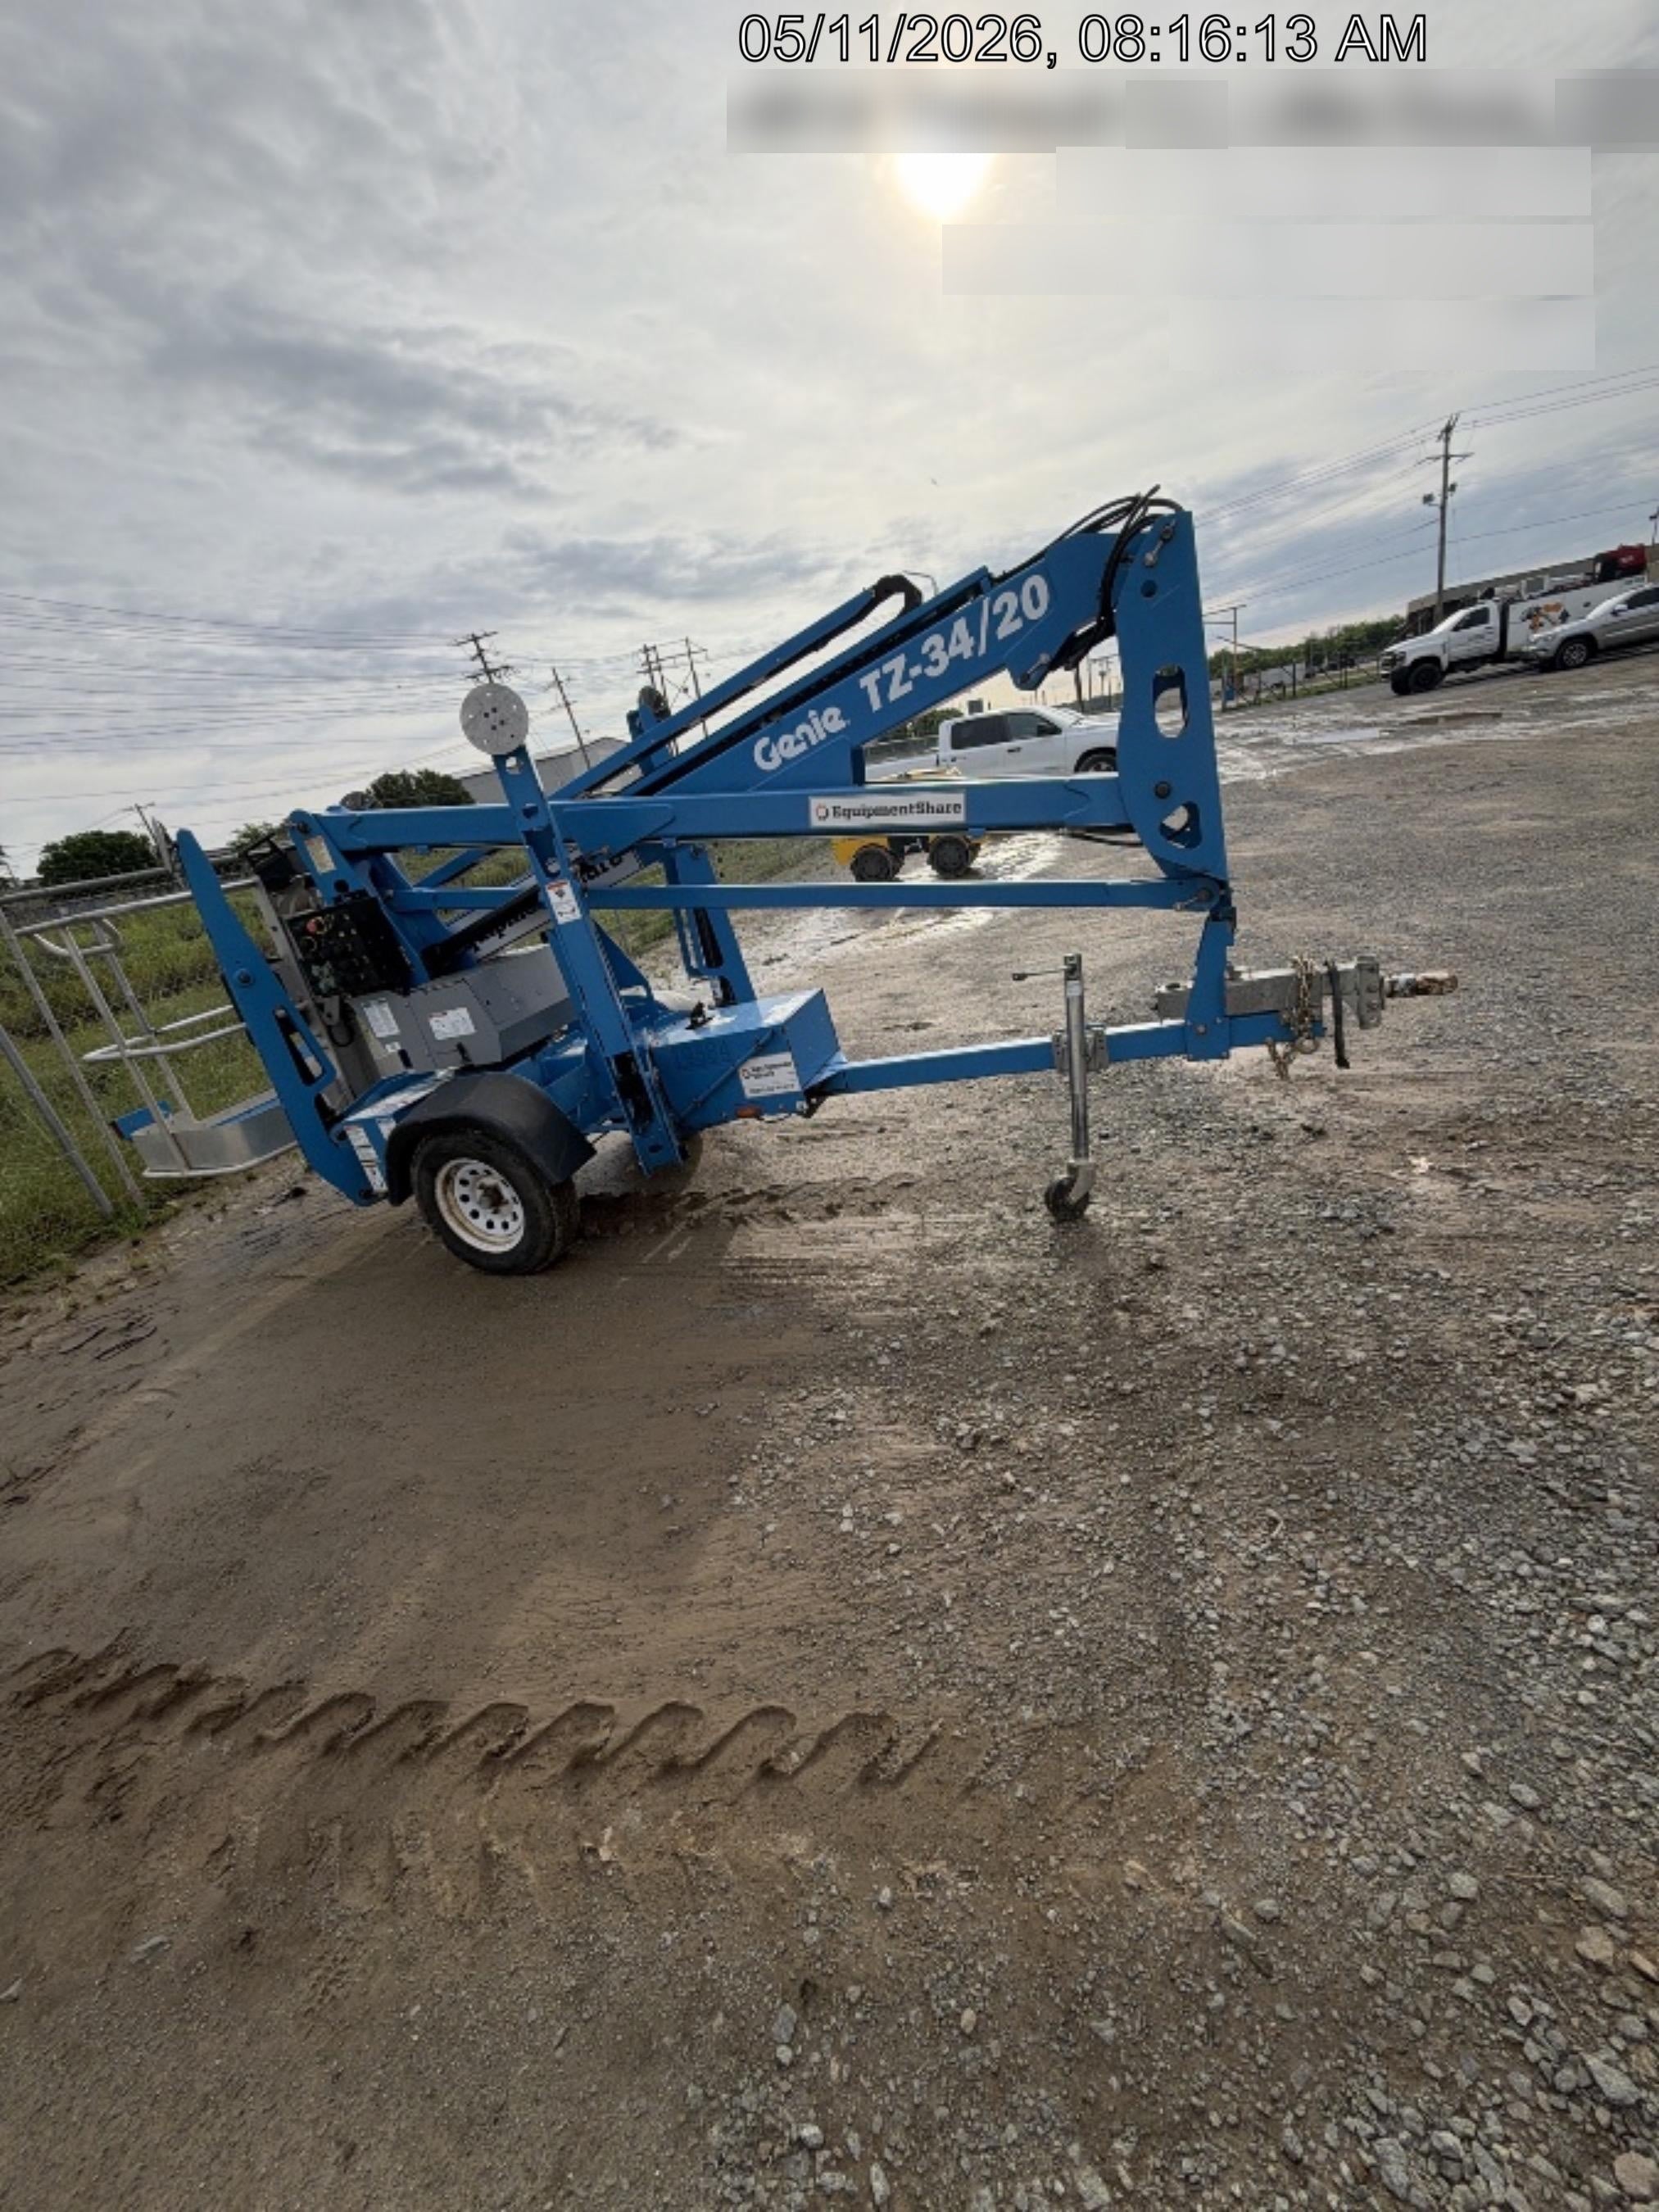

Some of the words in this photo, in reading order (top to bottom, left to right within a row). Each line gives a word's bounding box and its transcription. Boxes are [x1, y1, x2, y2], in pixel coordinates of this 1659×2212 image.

[754, 705, 847, 771] Genie
[859, 574, 1049, 713] TZ-34/20
[832, 800, 962, 821] EquipmentShare
